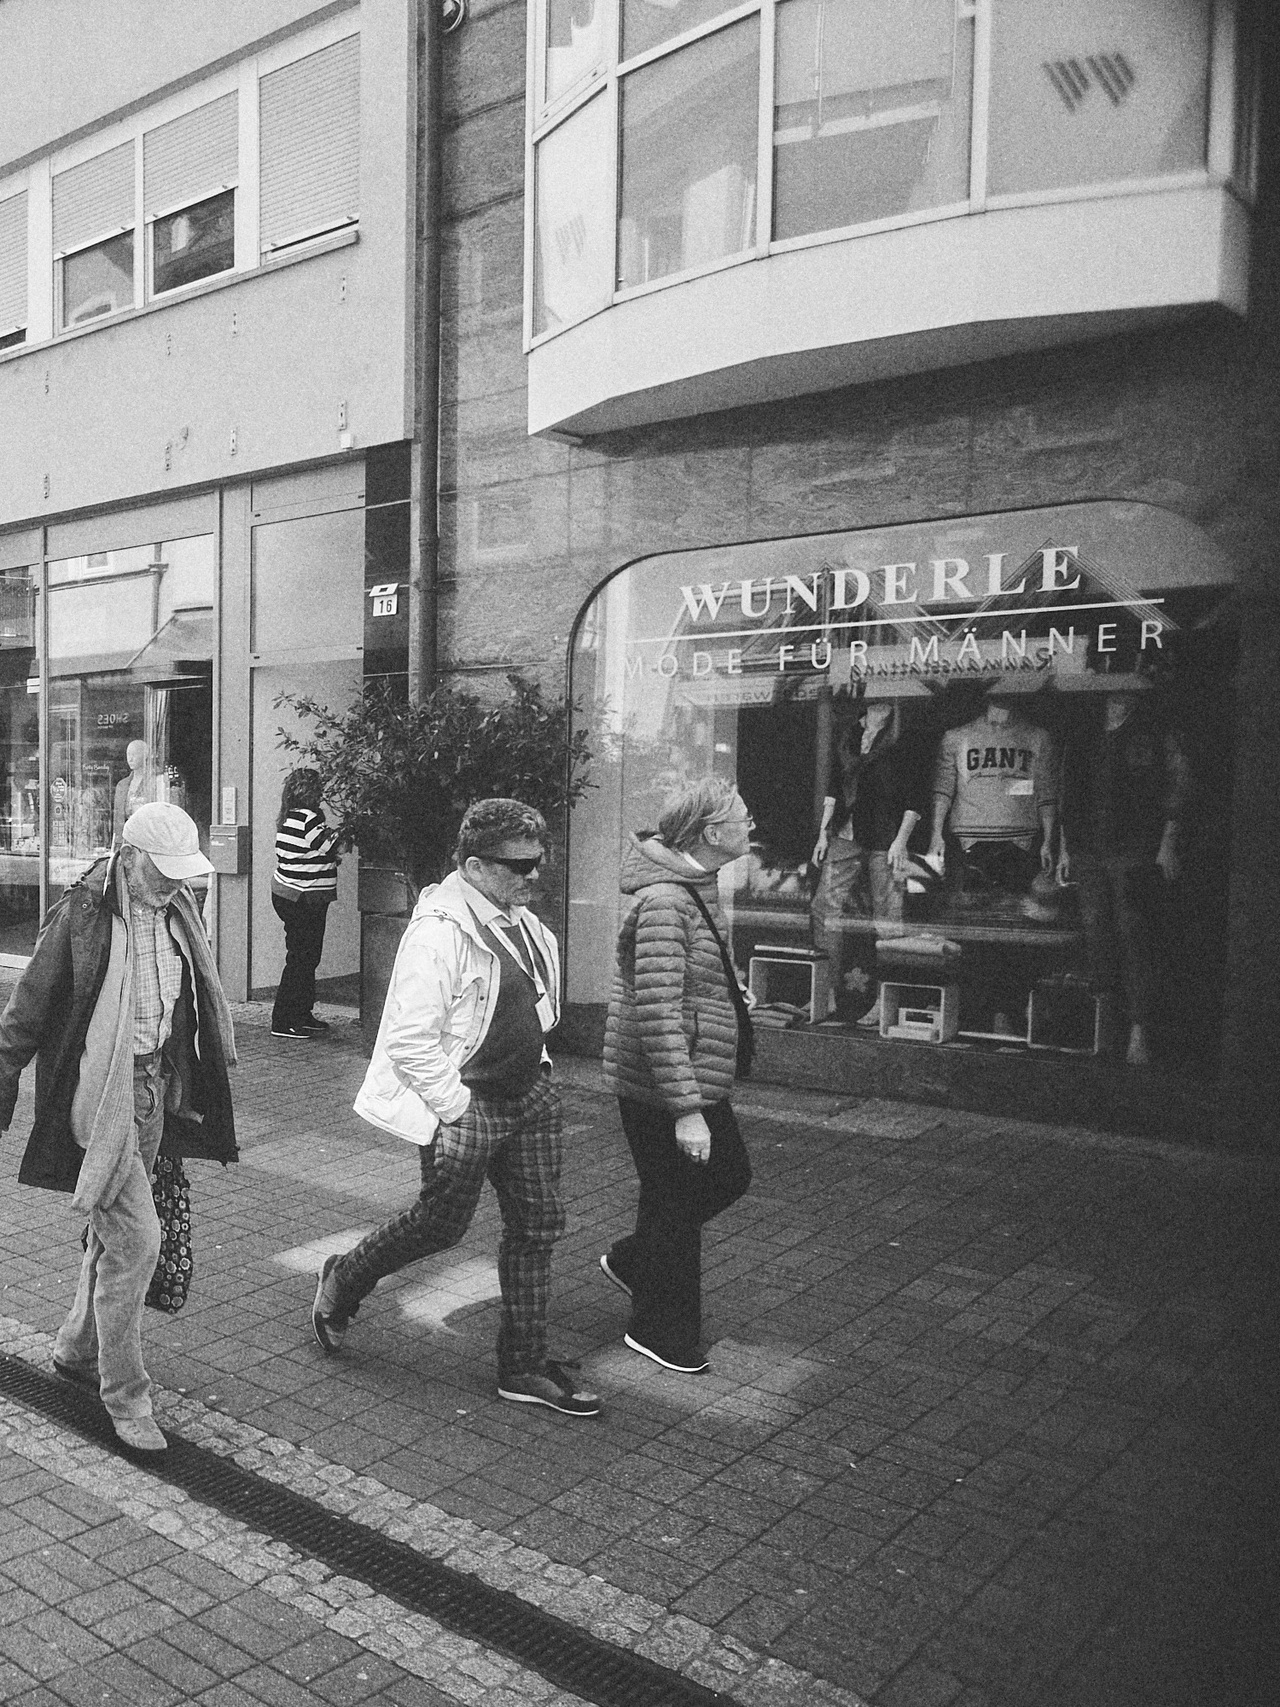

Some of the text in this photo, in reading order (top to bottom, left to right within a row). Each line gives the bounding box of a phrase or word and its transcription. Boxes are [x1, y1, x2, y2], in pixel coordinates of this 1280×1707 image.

[679, 545, 1081, 622] WUNDERLE
[379, 599, 393, 614] 16
[623, 620, 1164, 680] MODE FÜR MÄNNER
[966, 747, 1033, 772] GANT
